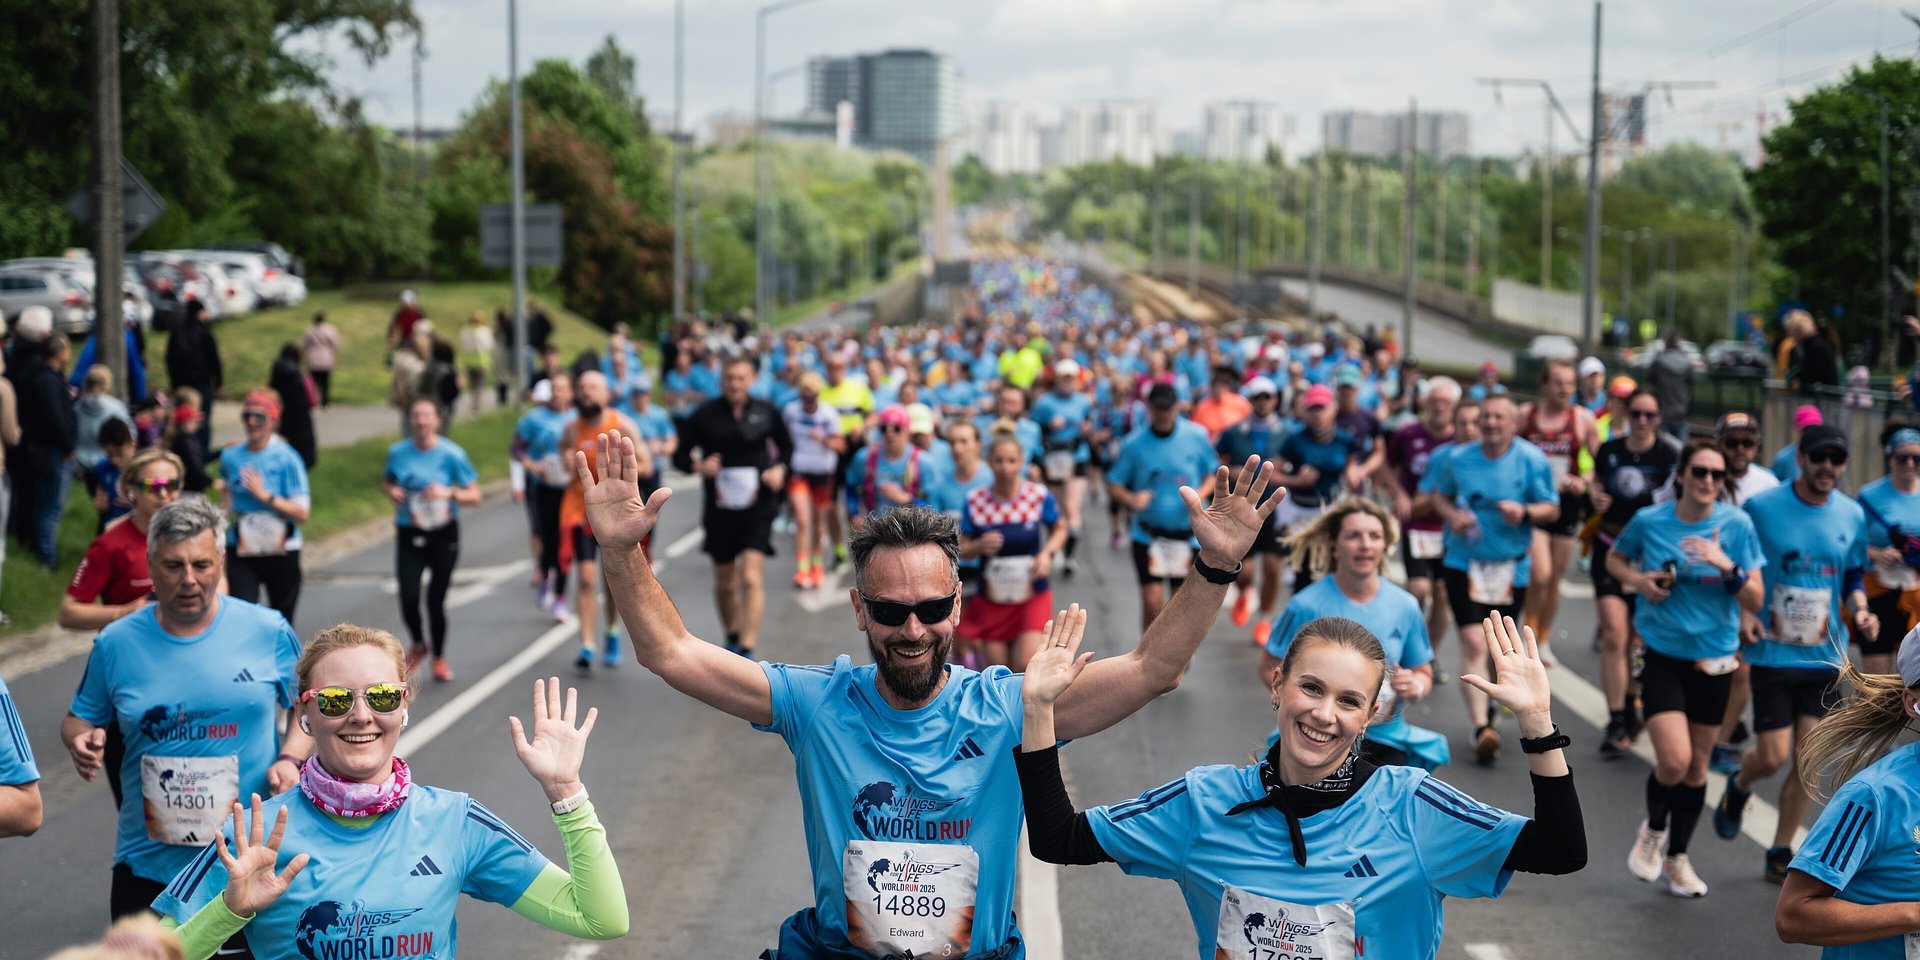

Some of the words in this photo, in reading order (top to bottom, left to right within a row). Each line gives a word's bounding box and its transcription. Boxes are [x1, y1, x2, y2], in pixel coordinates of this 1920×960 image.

[164, 794, 214, 810] 14301
[893, 796, 936, 810] WINGS
[897, 808, 923, 819] LIFE
[893, 861, 934, 874] WINGS
[897, 873, 922, 883] LIFE
[920, 884, 936, 893] 2025
[872, 894, 946, 918] 14889
[339, 911, 392, 927] WINGS
[346, 924, 377, 938] LIFE
[889, 928, 924, 938] Edward
[1268, 918, 1311, 935] WINGS
[1272, 929, 1297, 942] LIFE
[942, 943, 952, 957] 3
[1295, 944, 1313, 954] 2025
